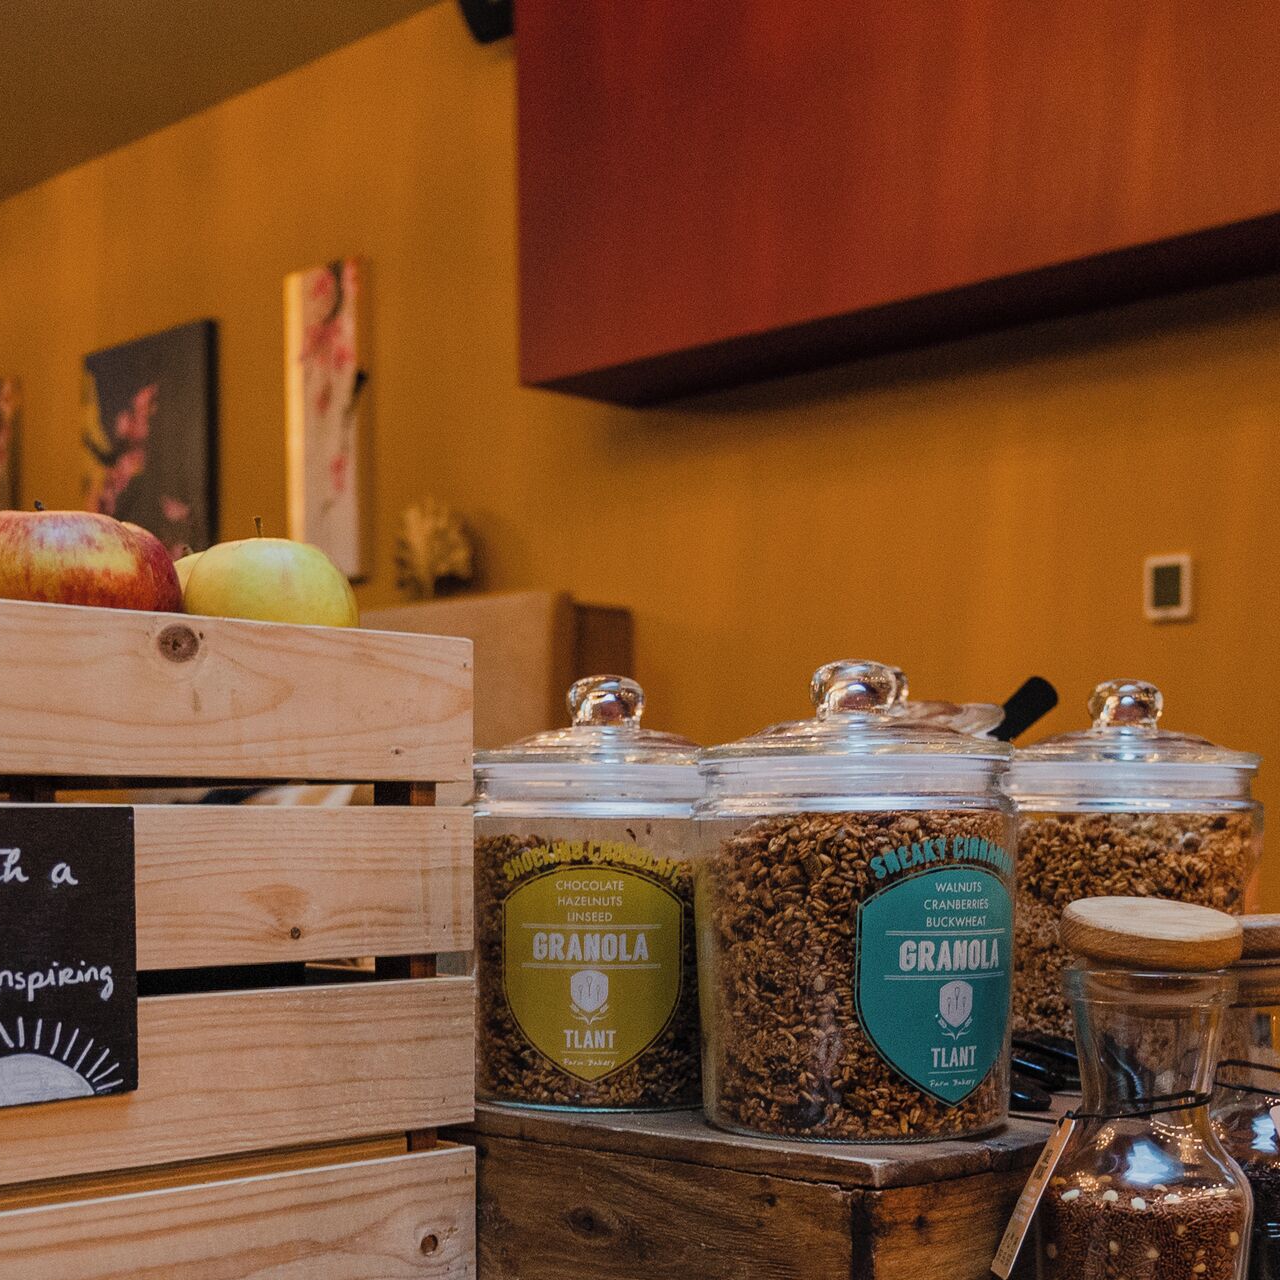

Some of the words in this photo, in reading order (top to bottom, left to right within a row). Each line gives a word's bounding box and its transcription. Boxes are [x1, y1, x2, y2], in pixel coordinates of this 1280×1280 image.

[870, 837, 947, 879] SNEAKY
[50, 860, 78, 888] a
[555, 880, 625, 891] CHOCOLATE
[935, 881, 982, 893] WALNUTS
[557, 896, 623, 906] HAZELNUTS
[924, 899, 989, 910] CRANBERRIES
[567, 912, 613, 922] LINSEED
[926, 915, 987, 927] BUCKWHEAT
[533, 932, 649, 962] GRANOLA
[899, 938, 999, 972] GRANOLA
[563, 1029, 617, 1049] TLANT
[931, 1046, 977, 1068] TLANT
